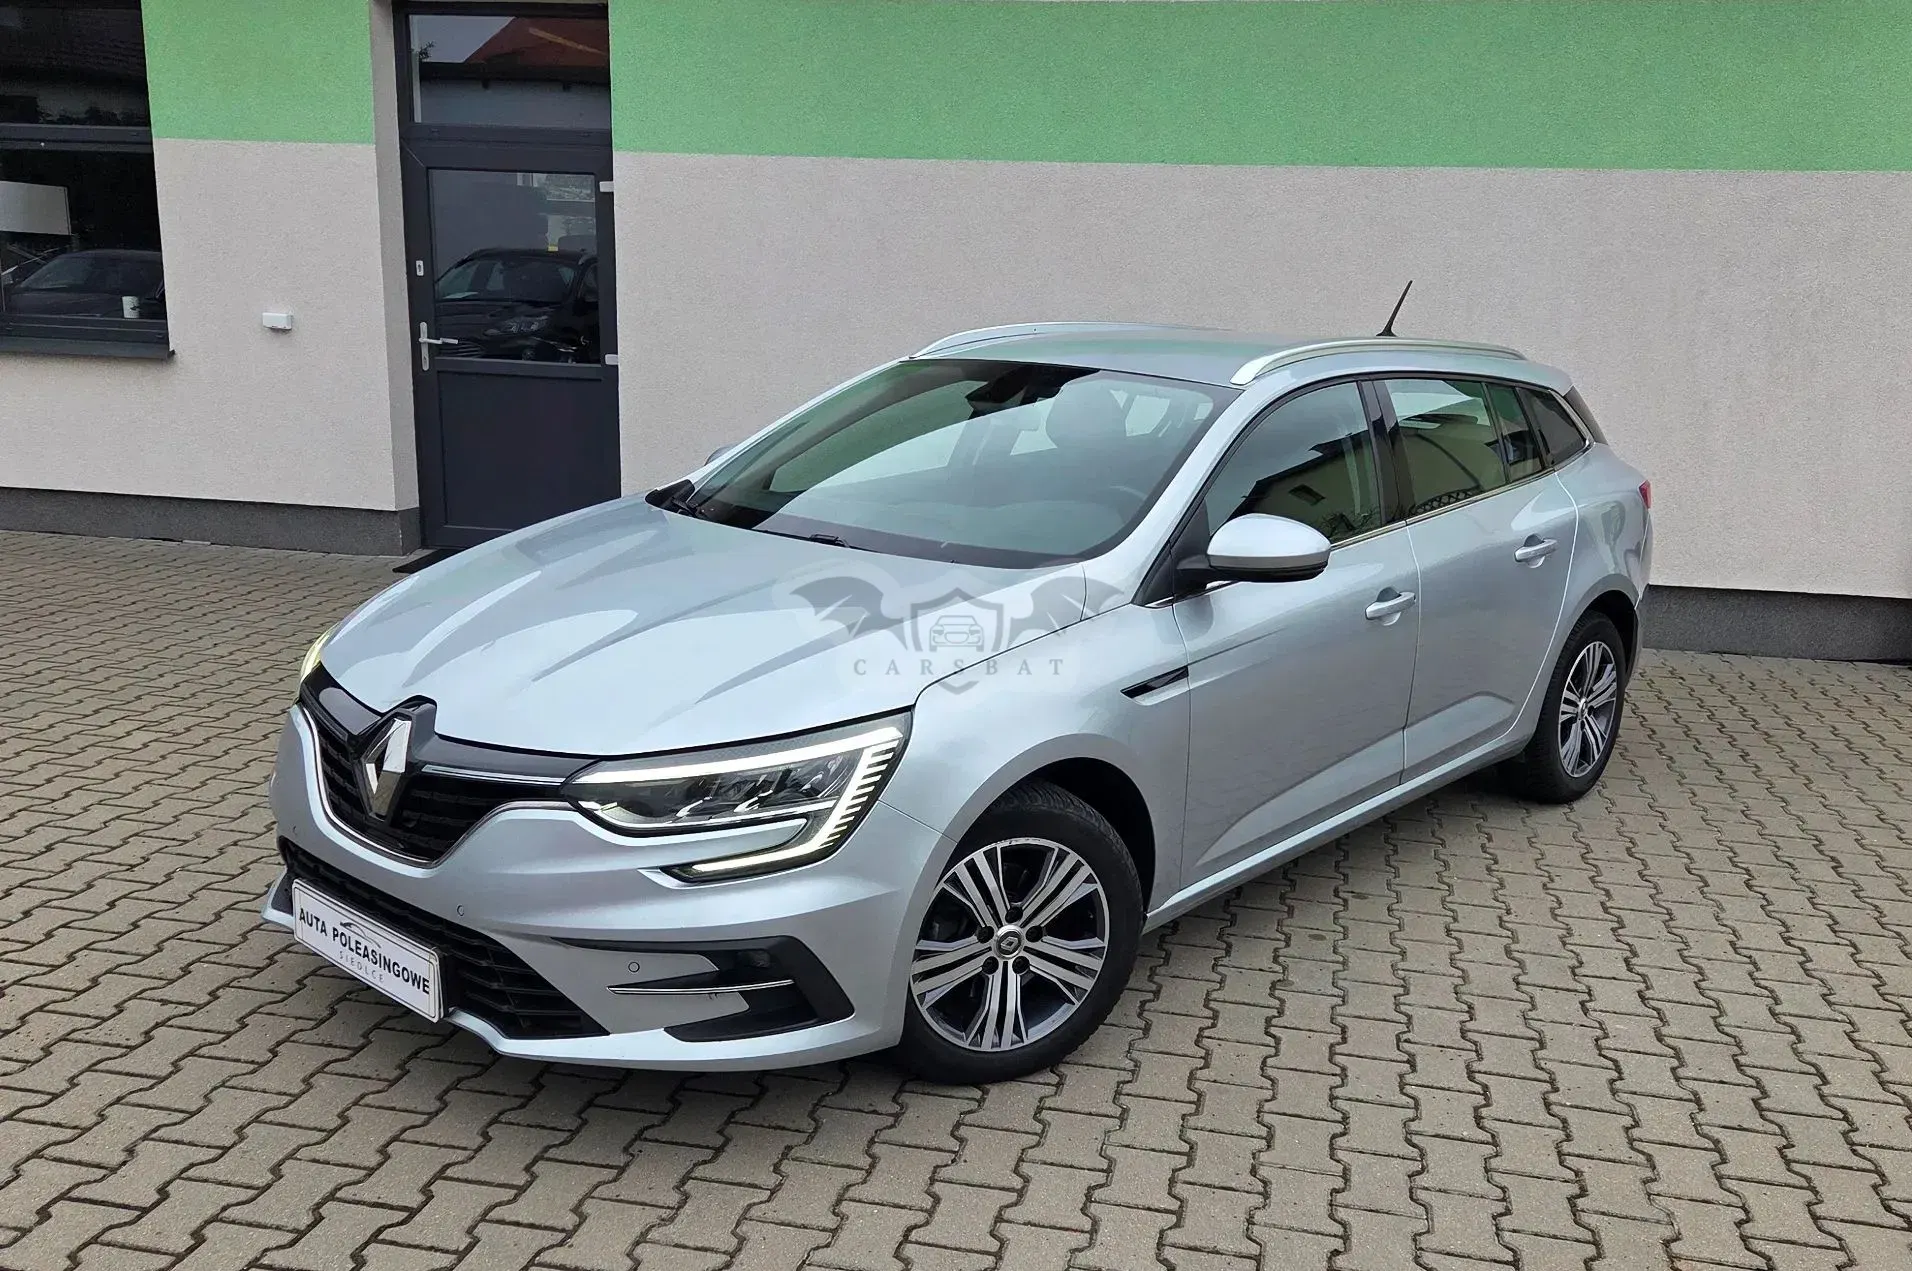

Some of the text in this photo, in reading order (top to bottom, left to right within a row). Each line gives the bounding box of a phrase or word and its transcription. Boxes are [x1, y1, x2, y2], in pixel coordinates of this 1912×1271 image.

[299, 908, 430, 994] AUTA POLEASINGOWE
[339, 950, 384, 983] SIEDLCE
